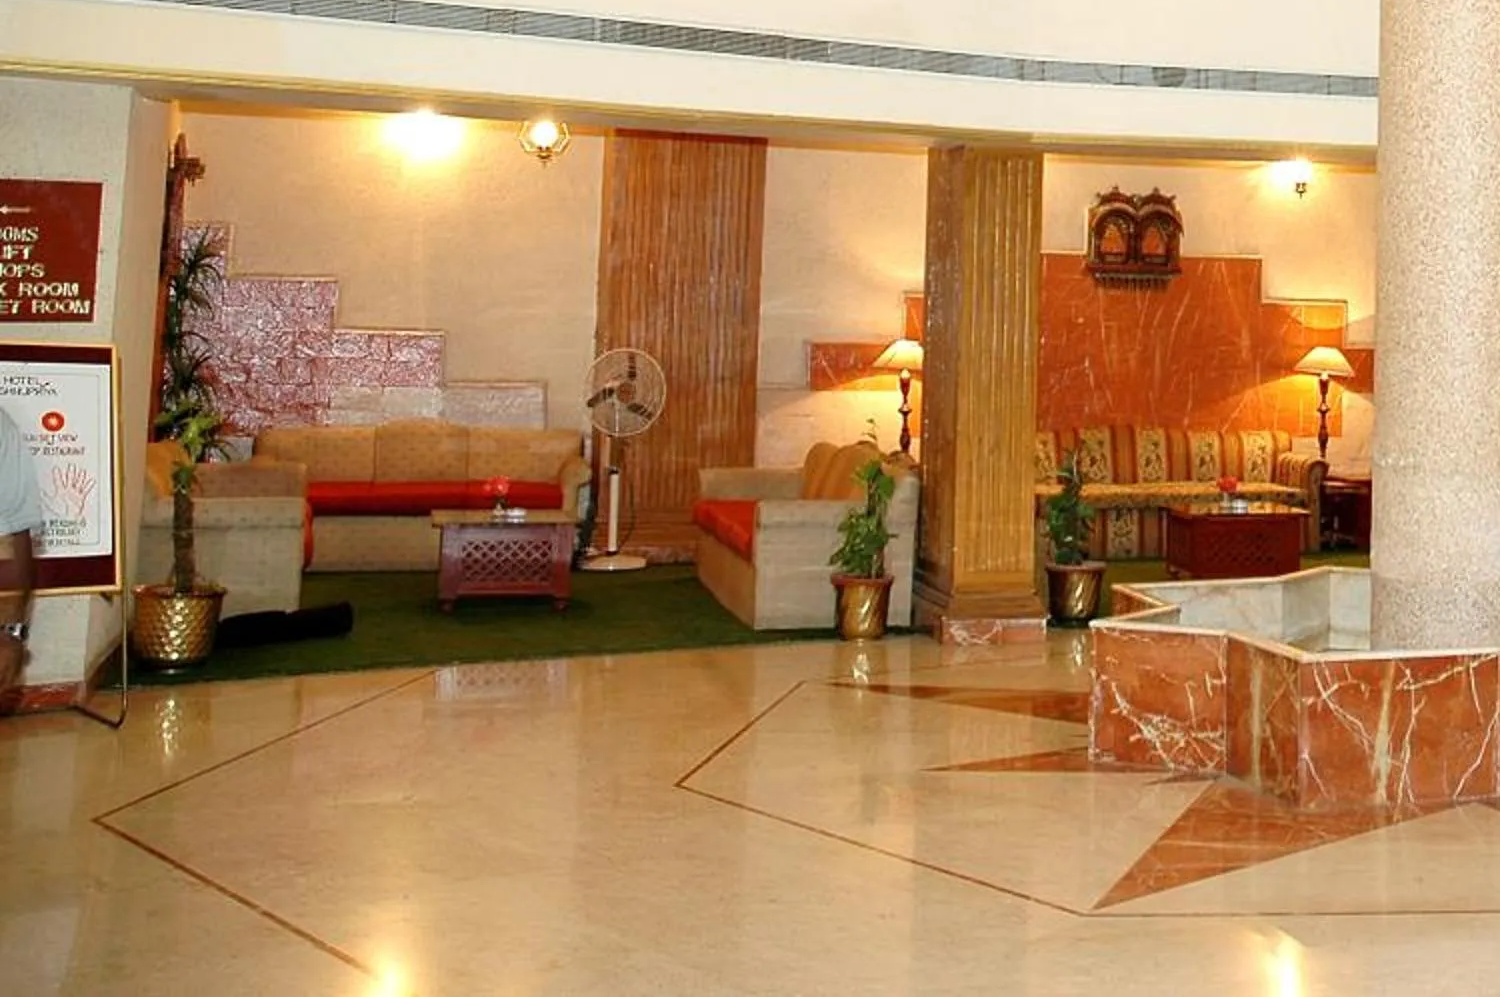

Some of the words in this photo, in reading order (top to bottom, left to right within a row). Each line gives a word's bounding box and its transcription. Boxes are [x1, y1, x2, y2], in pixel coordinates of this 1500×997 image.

[0, 226, 39, 242] OMS
[0, 263, 45, 278] OPS
[18, 282, 80, 297] ROOM
[31, 299, 91, 314] ROOM
